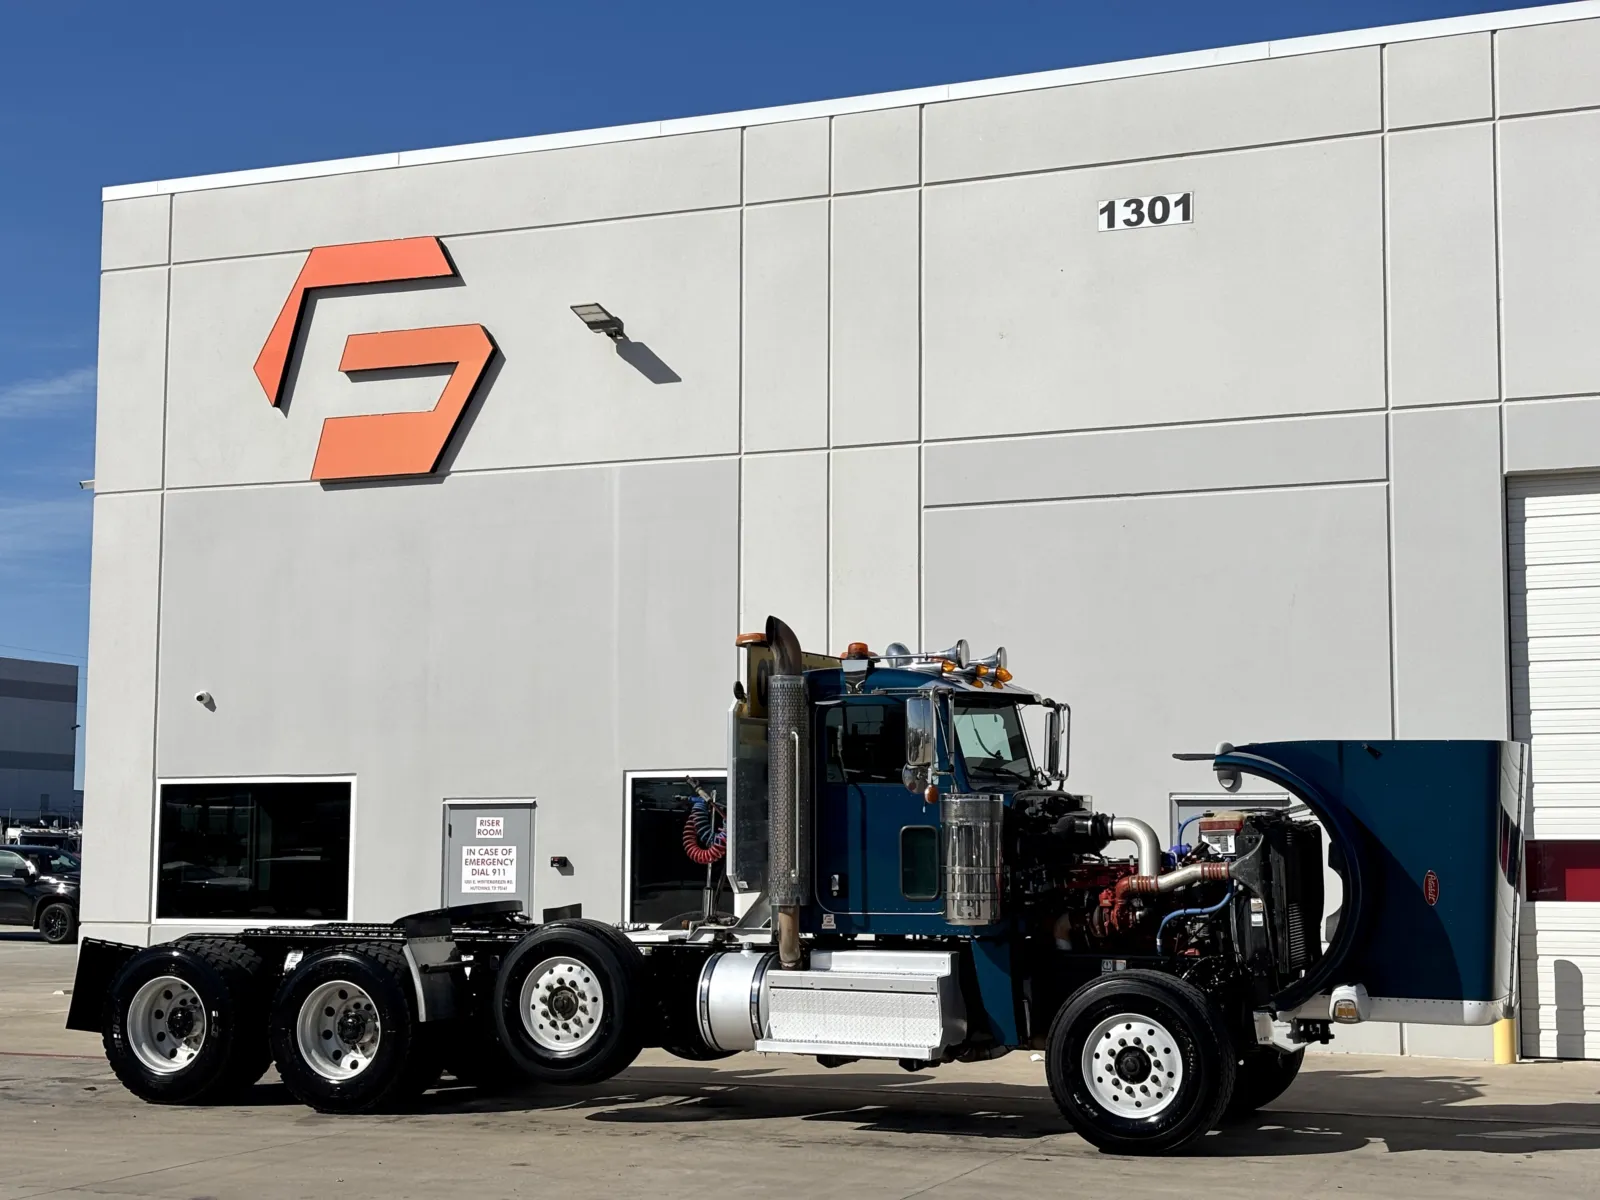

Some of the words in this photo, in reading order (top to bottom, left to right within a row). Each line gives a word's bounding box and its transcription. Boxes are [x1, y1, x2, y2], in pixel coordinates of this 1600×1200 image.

[1100, 193, 1190, 228] 1301
[480, 819, 500, 827] RISER
[466, 848, 476, 856] IN
[478, 848, 499, 856] CASE
[501, 848, 513, 856] OF
[464, 858, 514, 866] EMERGENCY
[471, 868, 490, 876] DIAL
[492, 868, 506, 876] 911
